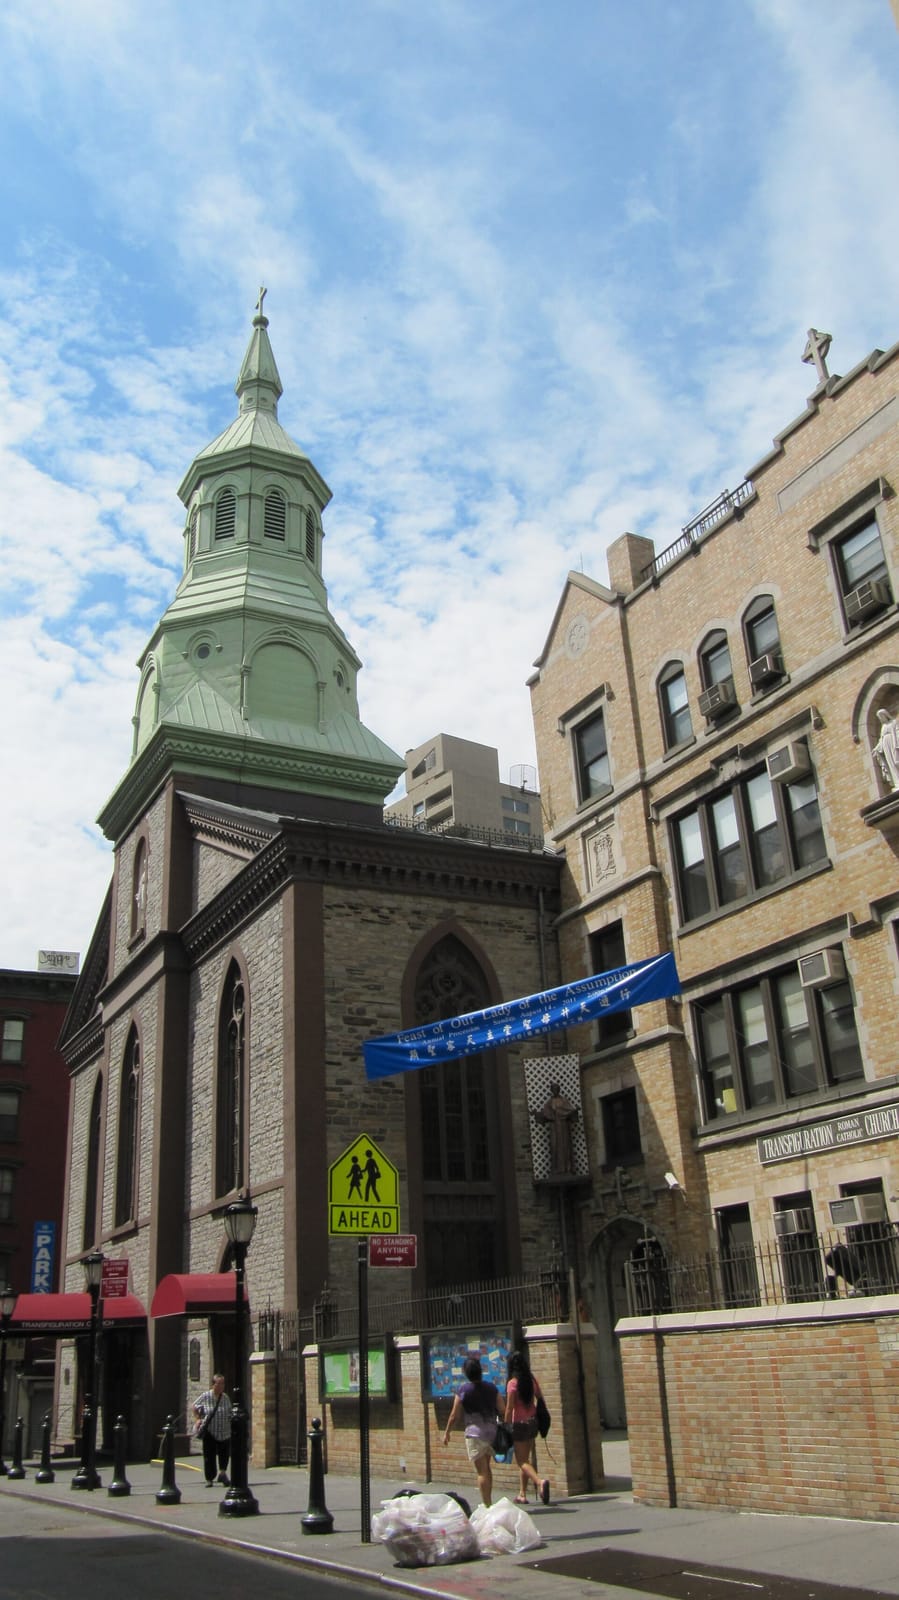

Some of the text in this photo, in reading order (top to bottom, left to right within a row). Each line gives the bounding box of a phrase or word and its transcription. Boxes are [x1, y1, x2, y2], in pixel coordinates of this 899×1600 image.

[397, 1029, 426, 1044] Feast
[433, 1023, 444, 1035] of
[450, 1015, 475, 1029] Our
[482, 1005, 512, 1021] Lady
[518, 998, 530, 1010] of
[538, 992, 558, 1004] the
[565, 968, 636, 997] Assumption
[763, 1109, 899, 1159] TRANSFIGURATION ROMAN CATHOLIC CHURCH
[338, 1210, 392, 1228] AHEAD
[372, 1238, 414, 1246] NO STANDING
[34, 1235, 52, 1287] PARK
[22, 1320, 114, 1329] TRANSFIGURATION CCH
